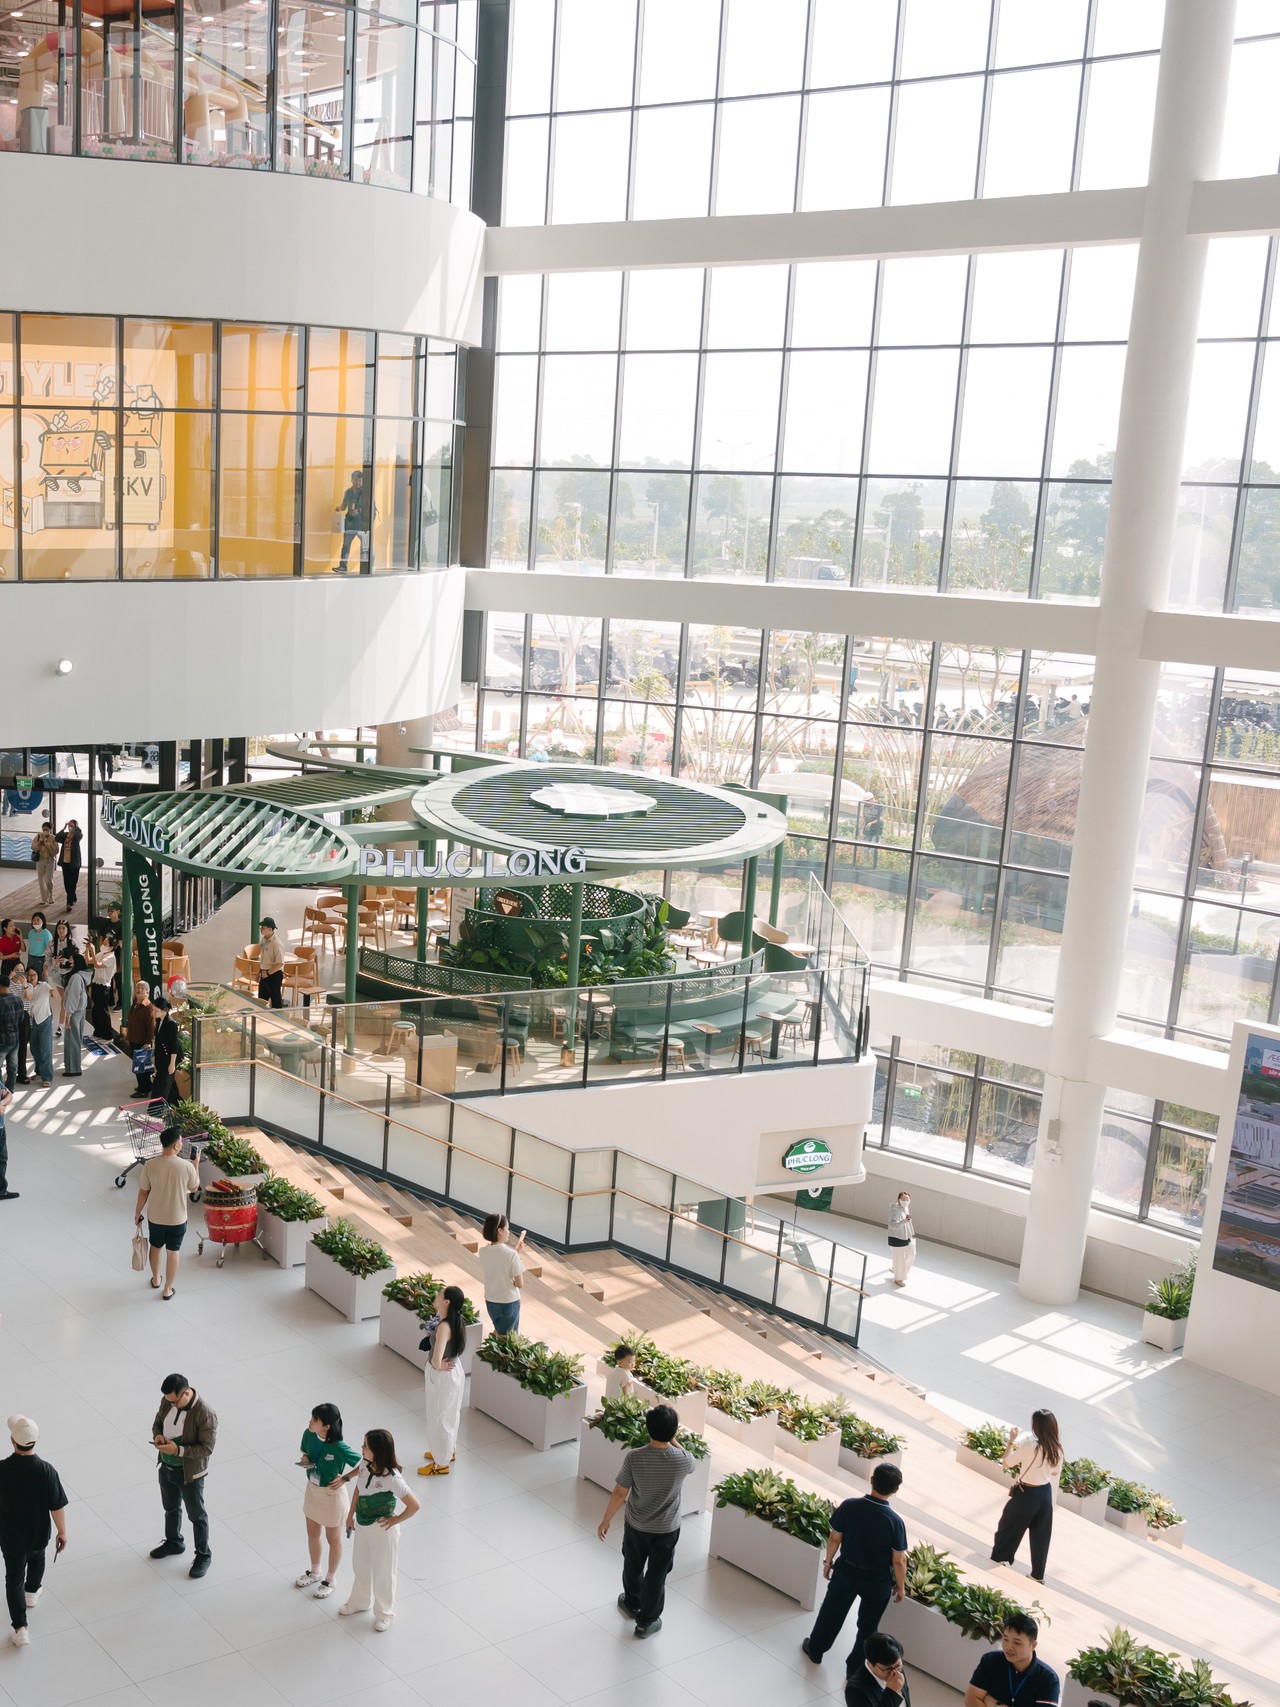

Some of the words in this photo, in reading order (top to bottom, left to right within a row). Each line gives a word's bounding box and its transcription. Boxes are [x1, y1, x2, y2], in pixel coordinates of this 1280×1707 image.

[6, 501, 29, 518] KV
[124, 809, 170, 854] LONG
[359, 849, 473, 878] PHUC
[484, 846, 587, 878] LONG
[139, 874, 154, 924] LONG
[145, 927, 160, 976] PHUC
[787, 1156, 808, 1166] PHUC
